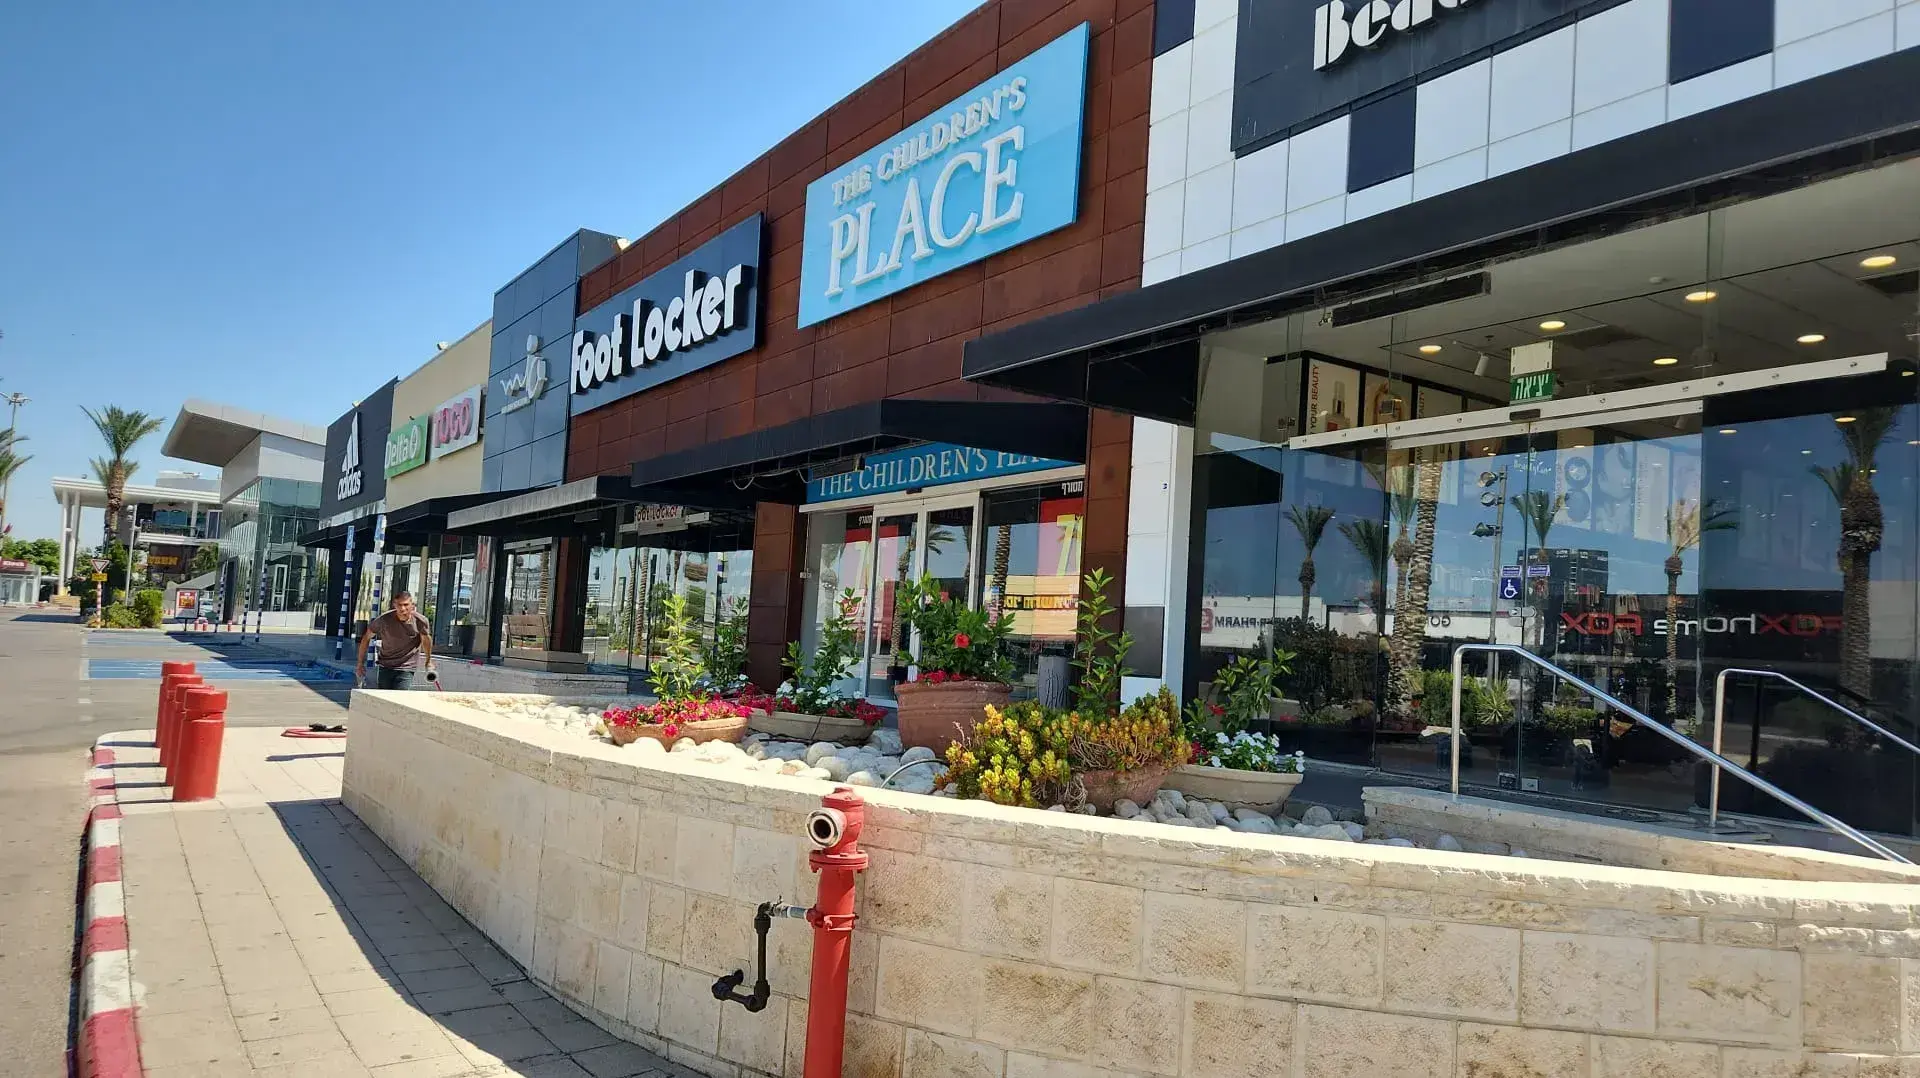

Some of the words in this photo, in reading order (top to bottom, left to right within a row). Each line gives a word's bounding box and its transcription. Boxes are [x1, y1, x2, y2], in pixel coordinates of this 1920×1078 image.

[1313, 0, 1468, 71] Bea
[832, 164, 873, 206] THE
[877, 76, 1027, 181] CHILDREN'S
[824, 126, 1025, 297] PLACE
[571, 313, 624, 394] Foot
[631, 263, 742, 368] Locker
[1311, 364, 1320, 401] BEAUTY
[1515, 373, 1549, 400] יציאה
[338, 470, 362, 501] adidas
[858, 446, 989, 491] CHILDREN'S
